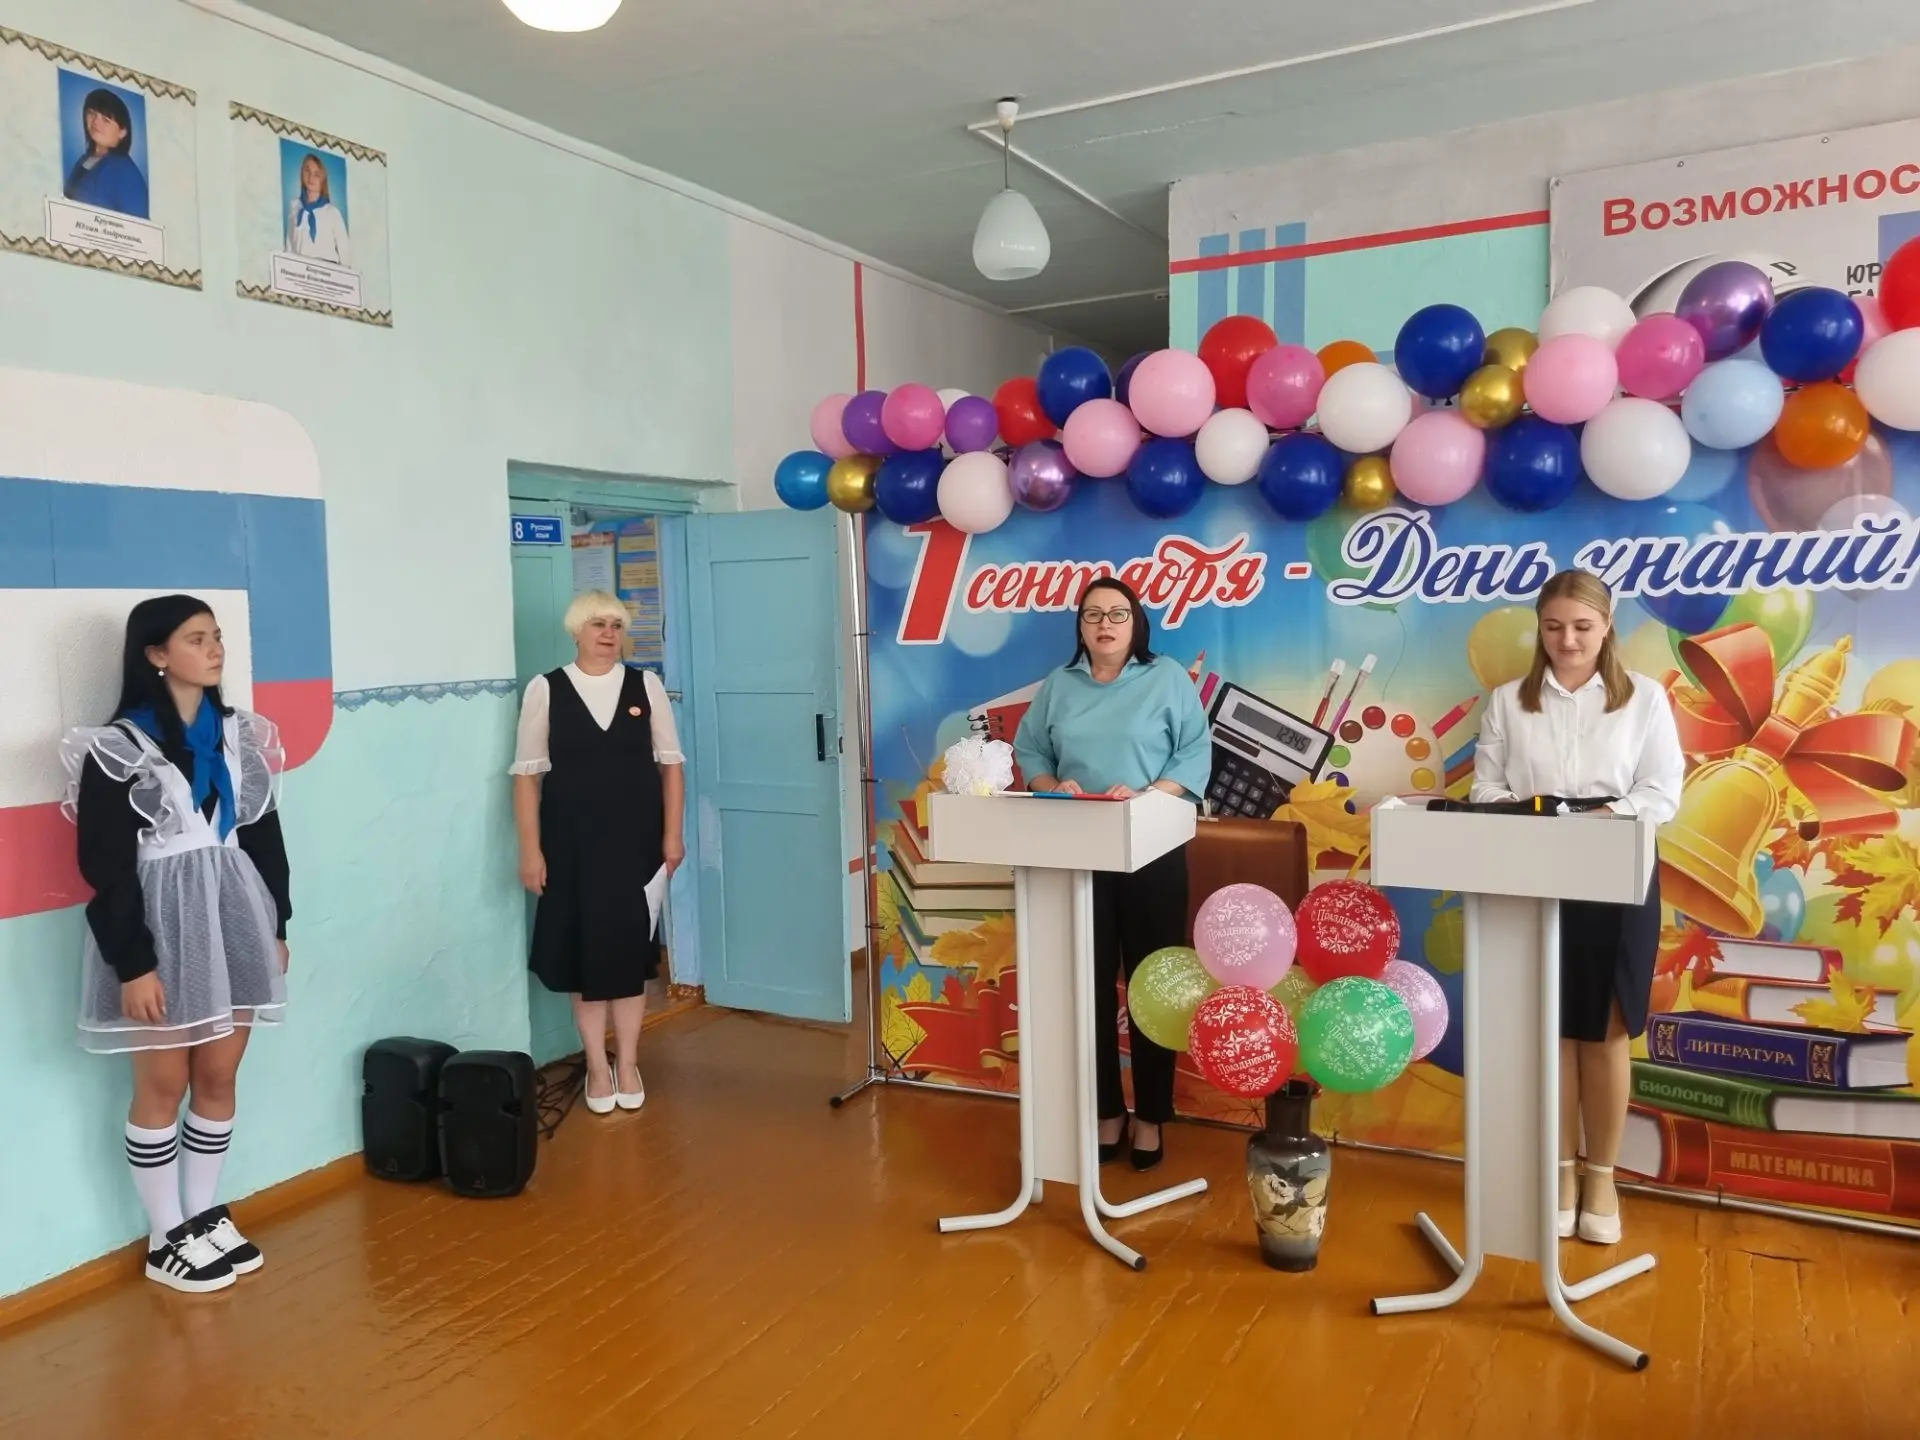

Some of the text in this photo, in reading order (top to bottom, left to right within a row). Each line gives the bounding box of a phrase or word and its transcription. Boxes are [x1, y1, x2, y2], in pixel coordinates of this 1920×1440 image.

[514, 521, 524, 540] 8
[900, 518, 968, 642] 1
[1332, 510, 1551, 600] День
[1683, 1038, 1796, 1066] ЛИТЕРАТУРА
[1638, 1080, 1725, 1109] БИОЛОГИЯ
[1730, 1150, 1876, 1188] МАТЕМАТИКА
